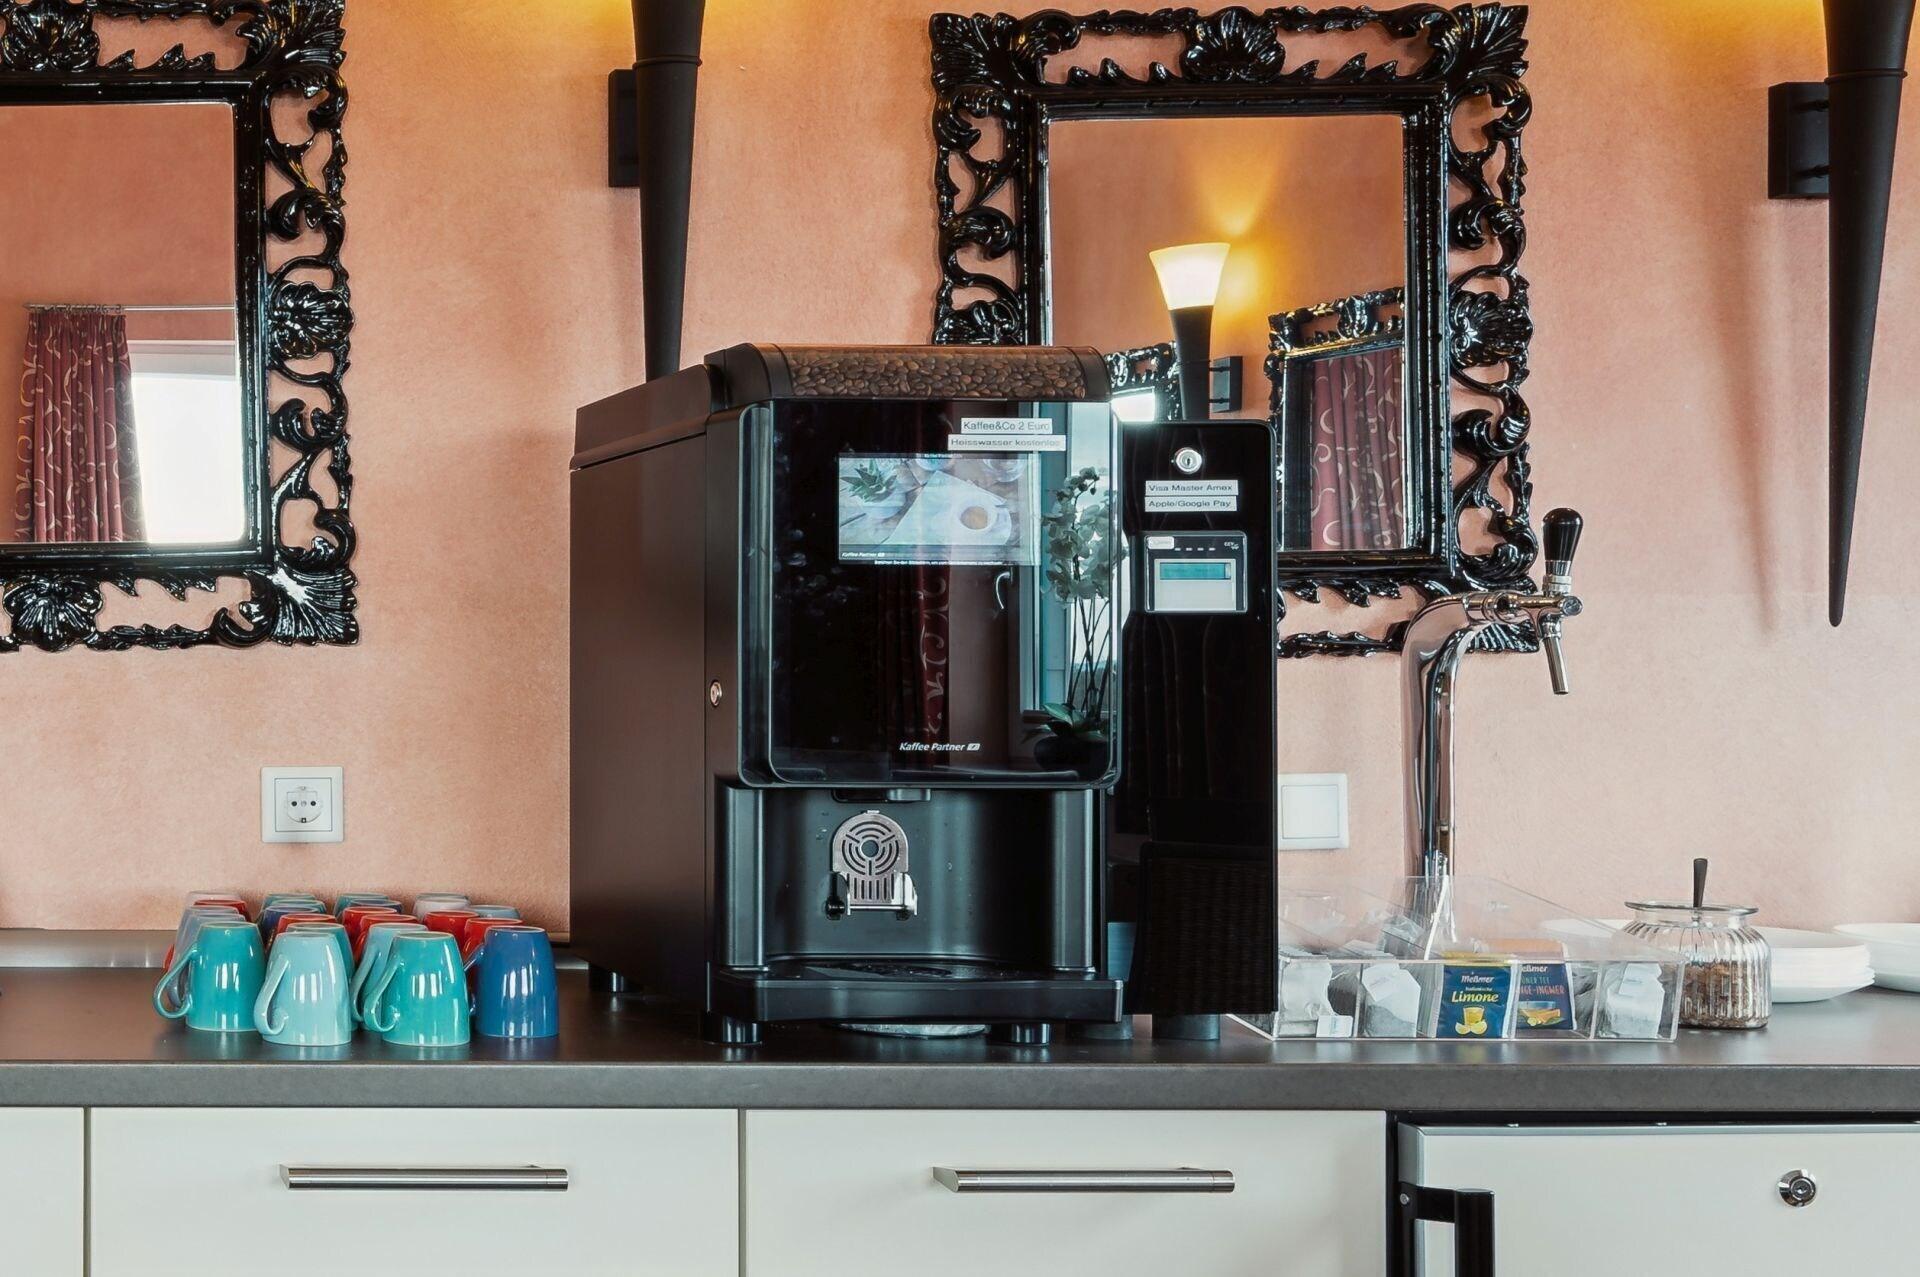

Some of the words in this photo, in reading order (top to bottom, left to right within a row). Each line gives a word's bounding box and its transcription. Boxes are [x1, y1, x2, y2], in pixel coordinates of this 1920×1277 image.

[963, 421, 1016, 431] Kaffee&Co
[1018, 421, 1025, 431] 2
[1027, 421, 1050, 431] Euro
[951, 439, 1012, 447] Heisswasser
[1148, 484, 1169, 493] Visa
[1171, 484, 1204, 493] Master
[1206, 484, 1233, 493] Amex
[1148, 500, 1211, 509] Apple/Google
[1213, 500, 1232, 509] Pay
[899, 742, 930, 751] Kaffee
[931, 743, 966, 751] Partner
[1521, 964, 1549, 973] eßmer
[1451, 991, 1499, 1003] Limone
